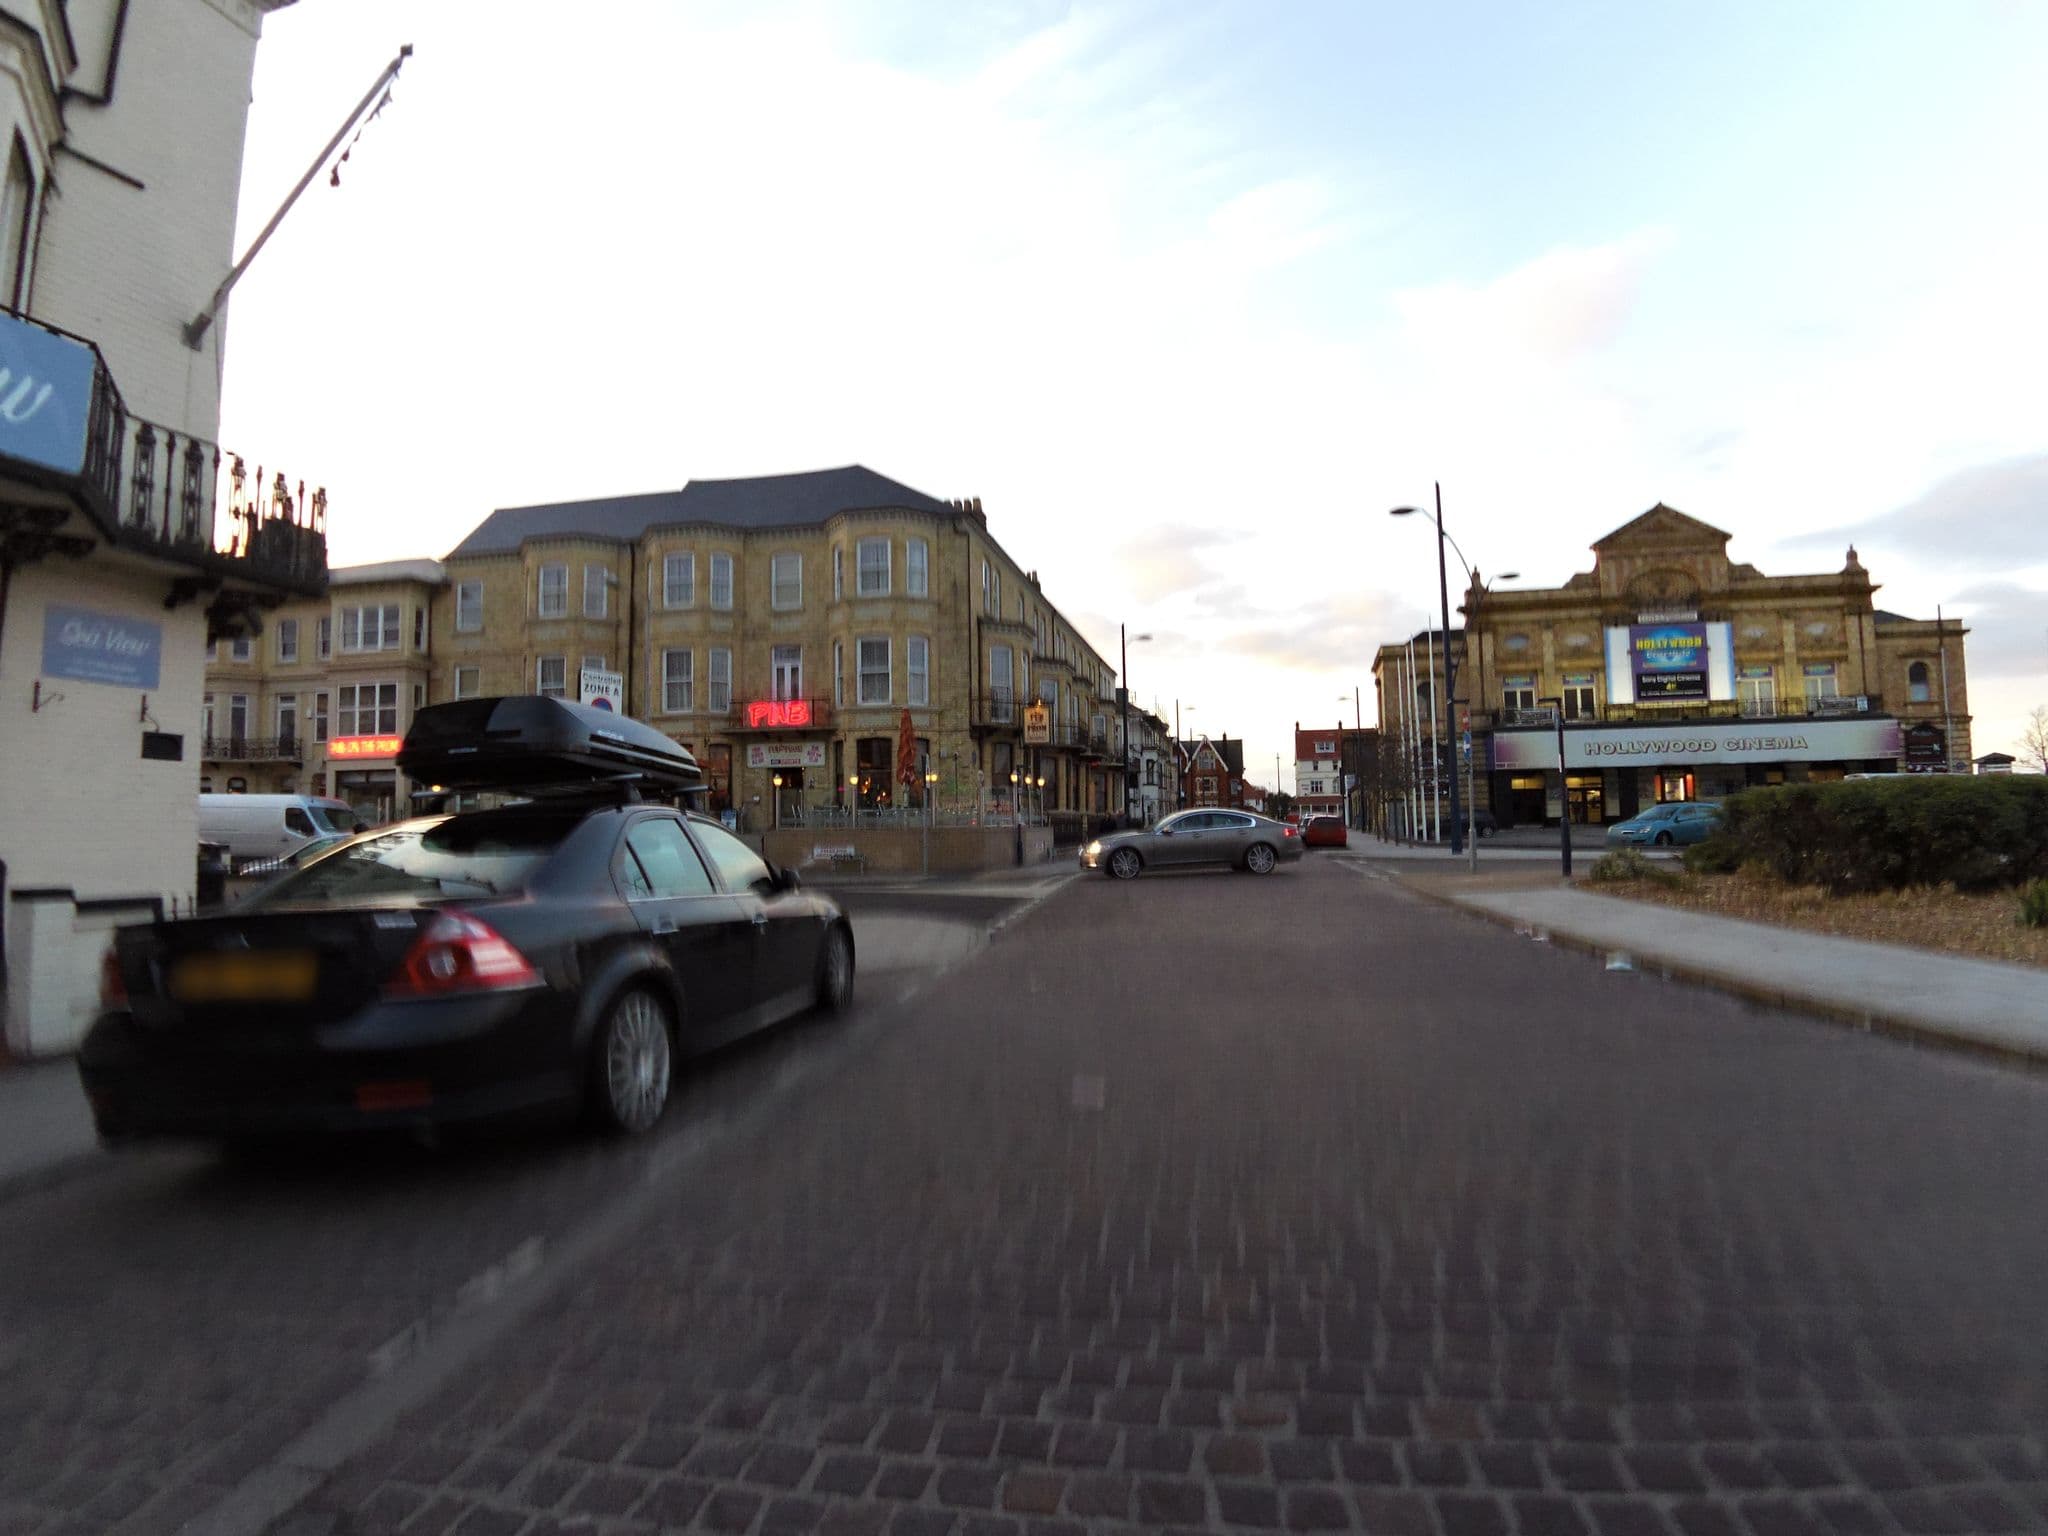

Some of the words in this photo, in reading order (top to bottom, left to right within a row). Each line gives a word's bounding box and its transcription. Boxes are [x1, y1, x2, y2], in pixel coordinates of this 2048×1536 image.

[1636, 635, 1703, 651] HOLLYWOOD
[584, 683, 611, 696] ZONE
[613, 687, 620, 697] A
[748, 700, 809, 728] PUB
[1584, 738, 1716, 756] HOLLYWOOD
[1723, 735, 1808, 752] CINEMA
